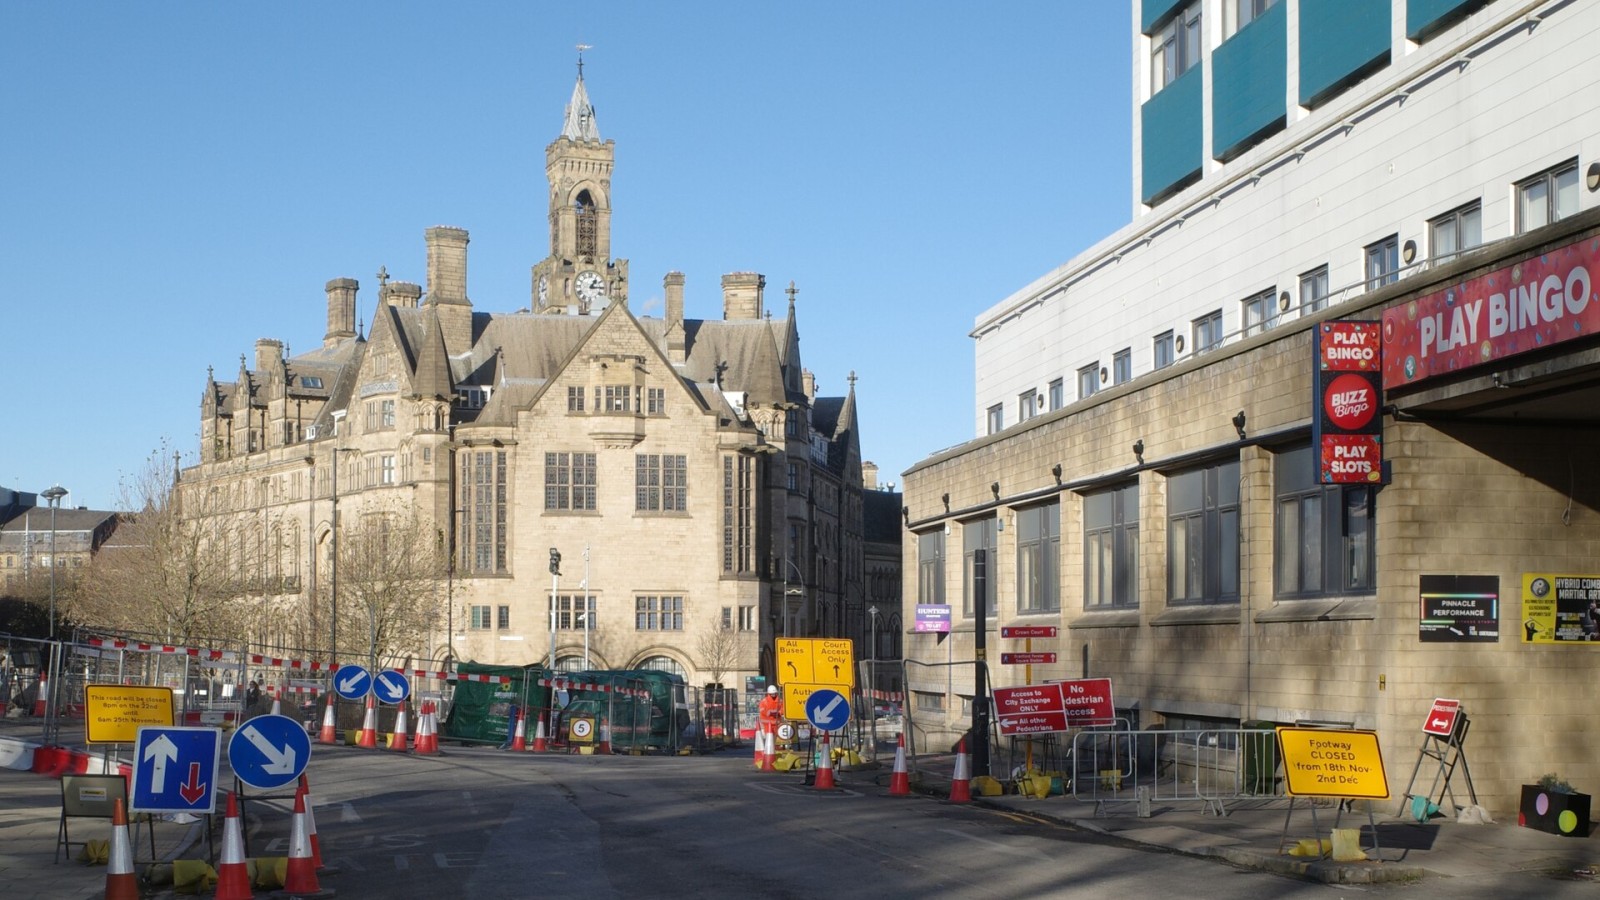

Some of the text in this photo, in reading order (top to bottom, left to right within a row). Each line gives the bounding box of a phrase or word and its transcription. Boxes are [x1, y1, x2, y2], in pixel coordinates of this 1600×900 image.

[1421, 266, 1591, 358] PLAY BINGO
[1334, 332, 1367, 344] PLAY
[1327, 347, 1373, 360] BINGO
[1332, 389, 1368, 407] BUZZ
[1335, 403, 1369, 417] Bingo
[1335, 446, 1368, 458] PLAY
[1331, 461, 1372, 473] SLOTS
[1555, 578, 1580, 589] HYBRID
[1559, 590, 1587, 599] MARTIAL
[827, 656, 846, 664] Only
[1070, 685, 1084, 693] No
[1063, 696, 1104, 705] destrian
[578, 724, 585, 733] 5
[1310, 740, 1351, 750] Footway
[1311, 751, 1355, 760] CLOSED
[1297, 762, 1321, 770] from
[1323, 763, 1346, 771] 18th
[1317, 774, 1359, 784] 2nd Dec
